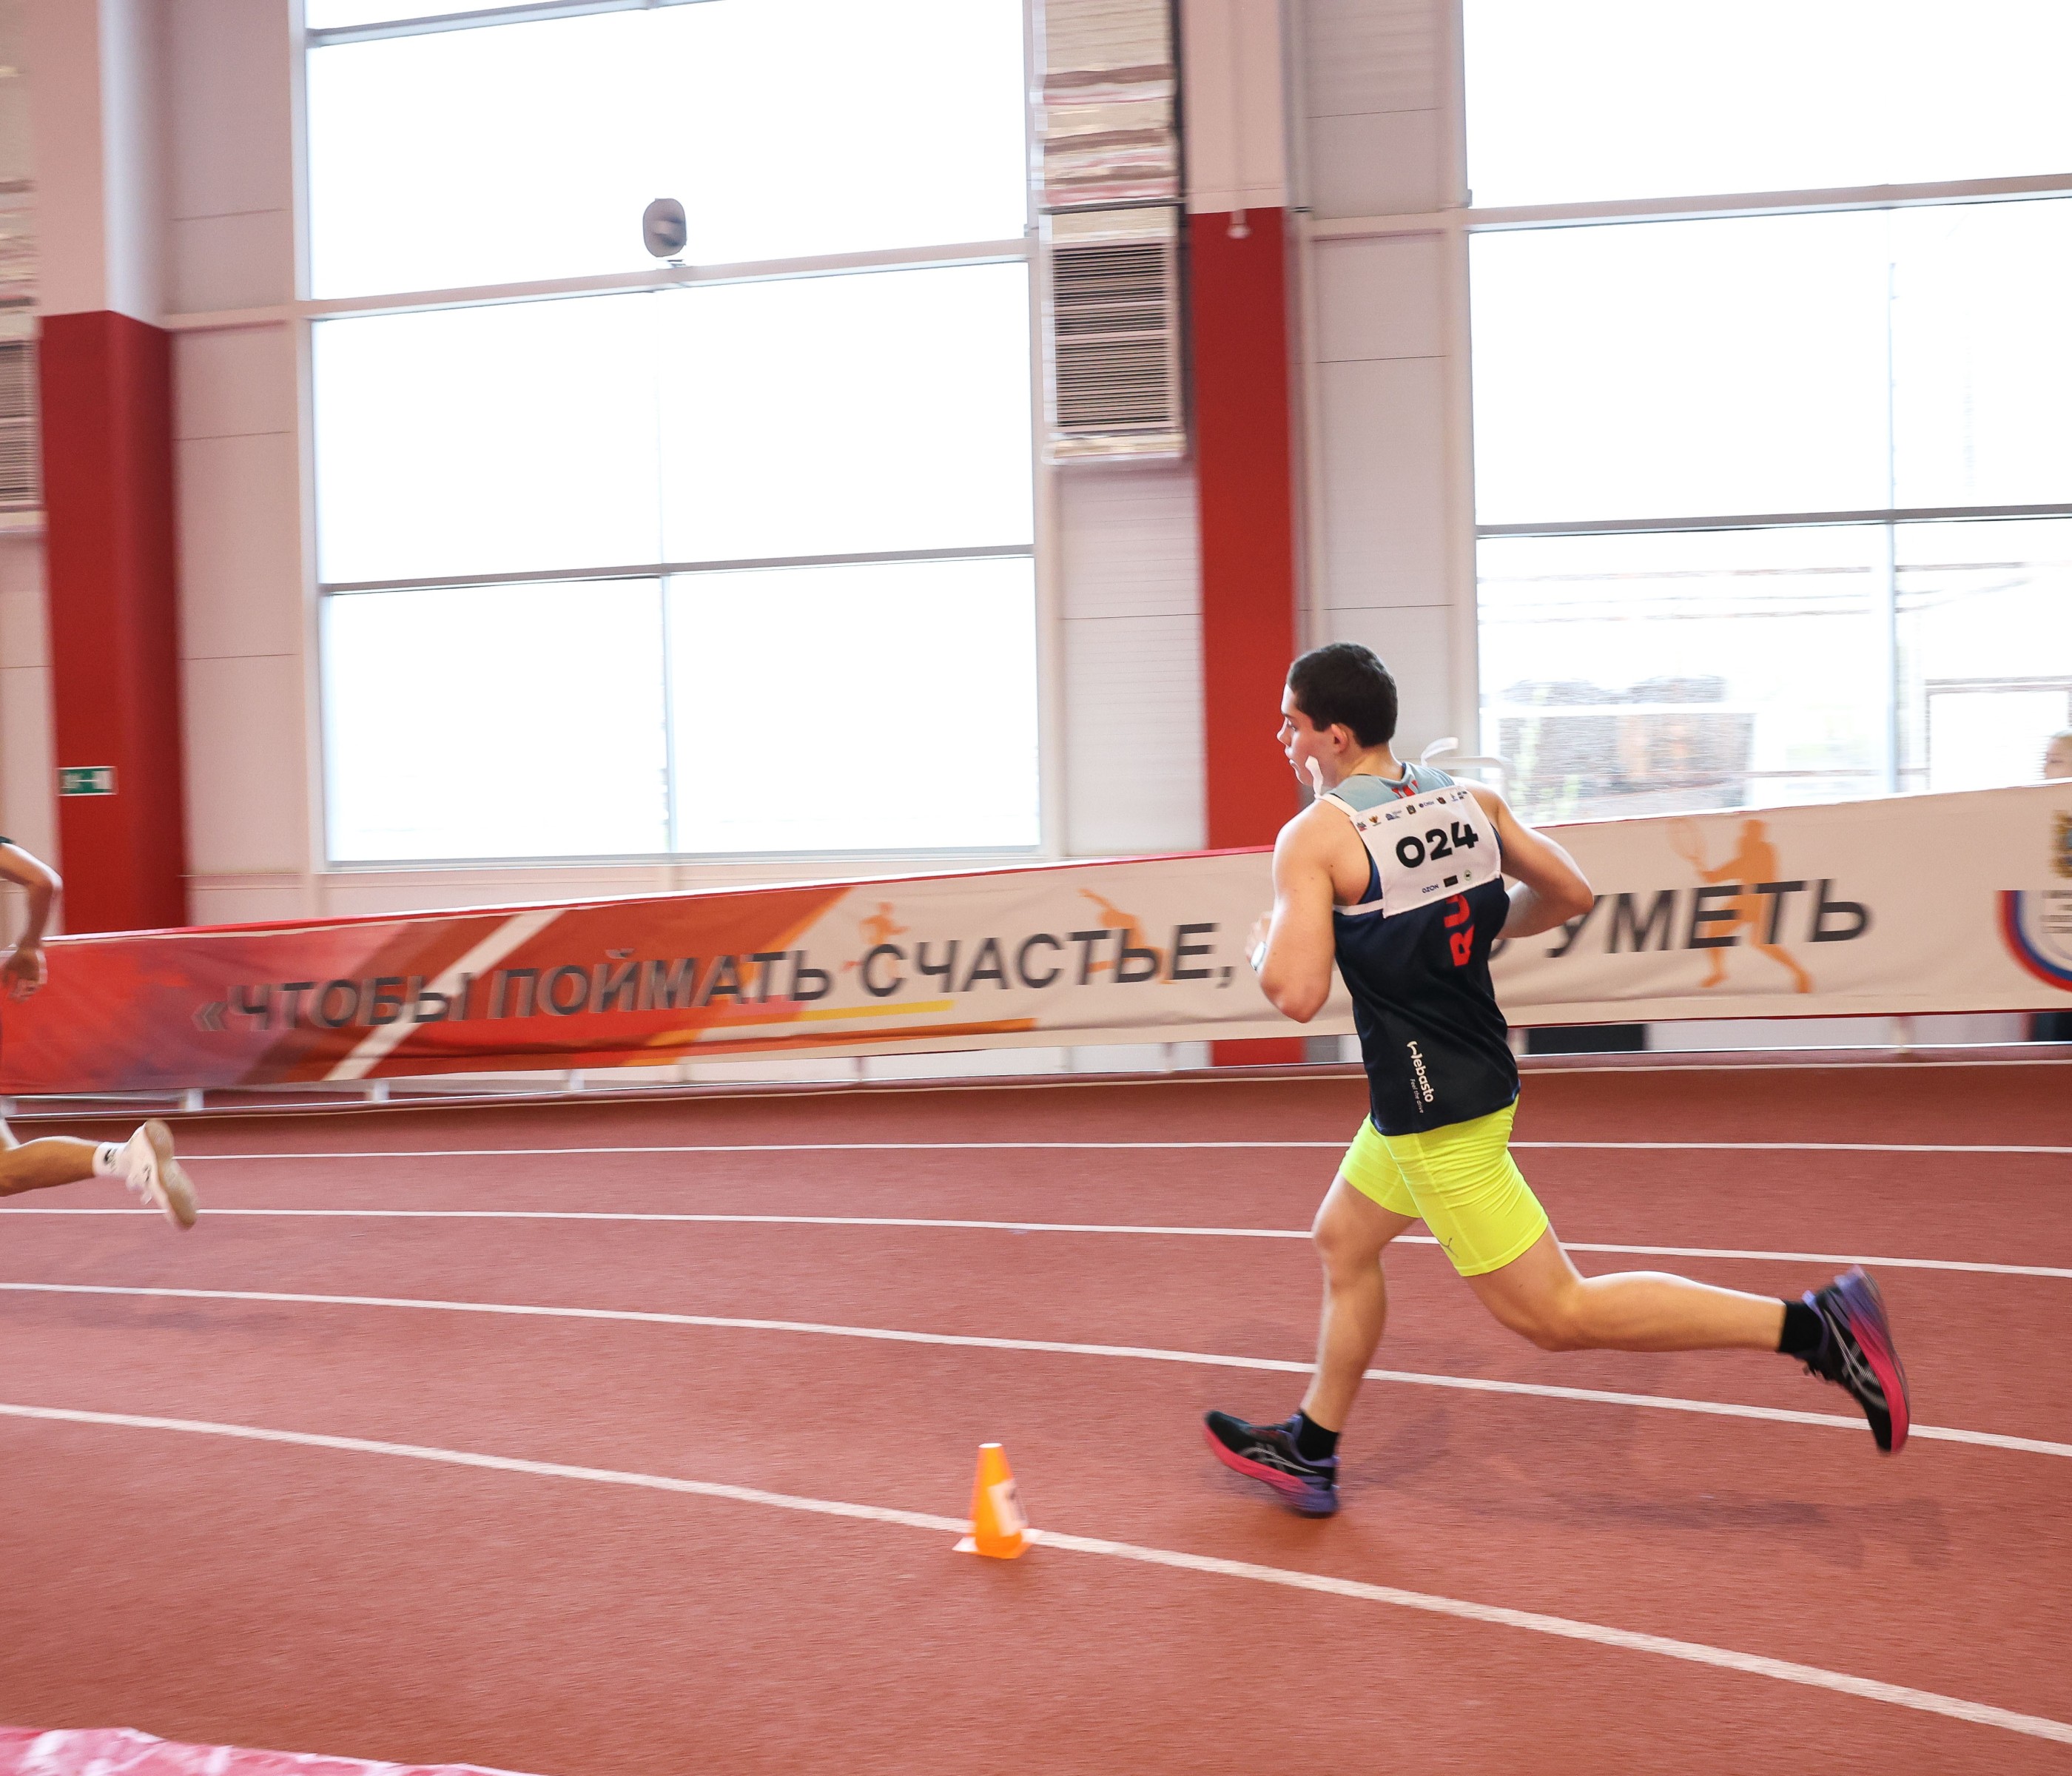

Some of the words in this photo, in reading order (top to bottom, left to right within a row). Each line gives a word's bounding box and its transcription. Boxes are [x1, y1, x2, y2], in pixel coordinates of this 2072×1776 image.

[1396, 821, 1479, 868] 024
[487, 948, 834, 1019] ПОЙМАТЬ
[858, 922, 1236, 998] СЧАСТЬЕ,
[1545, 878, 1873, 958] УМЕТЬ
